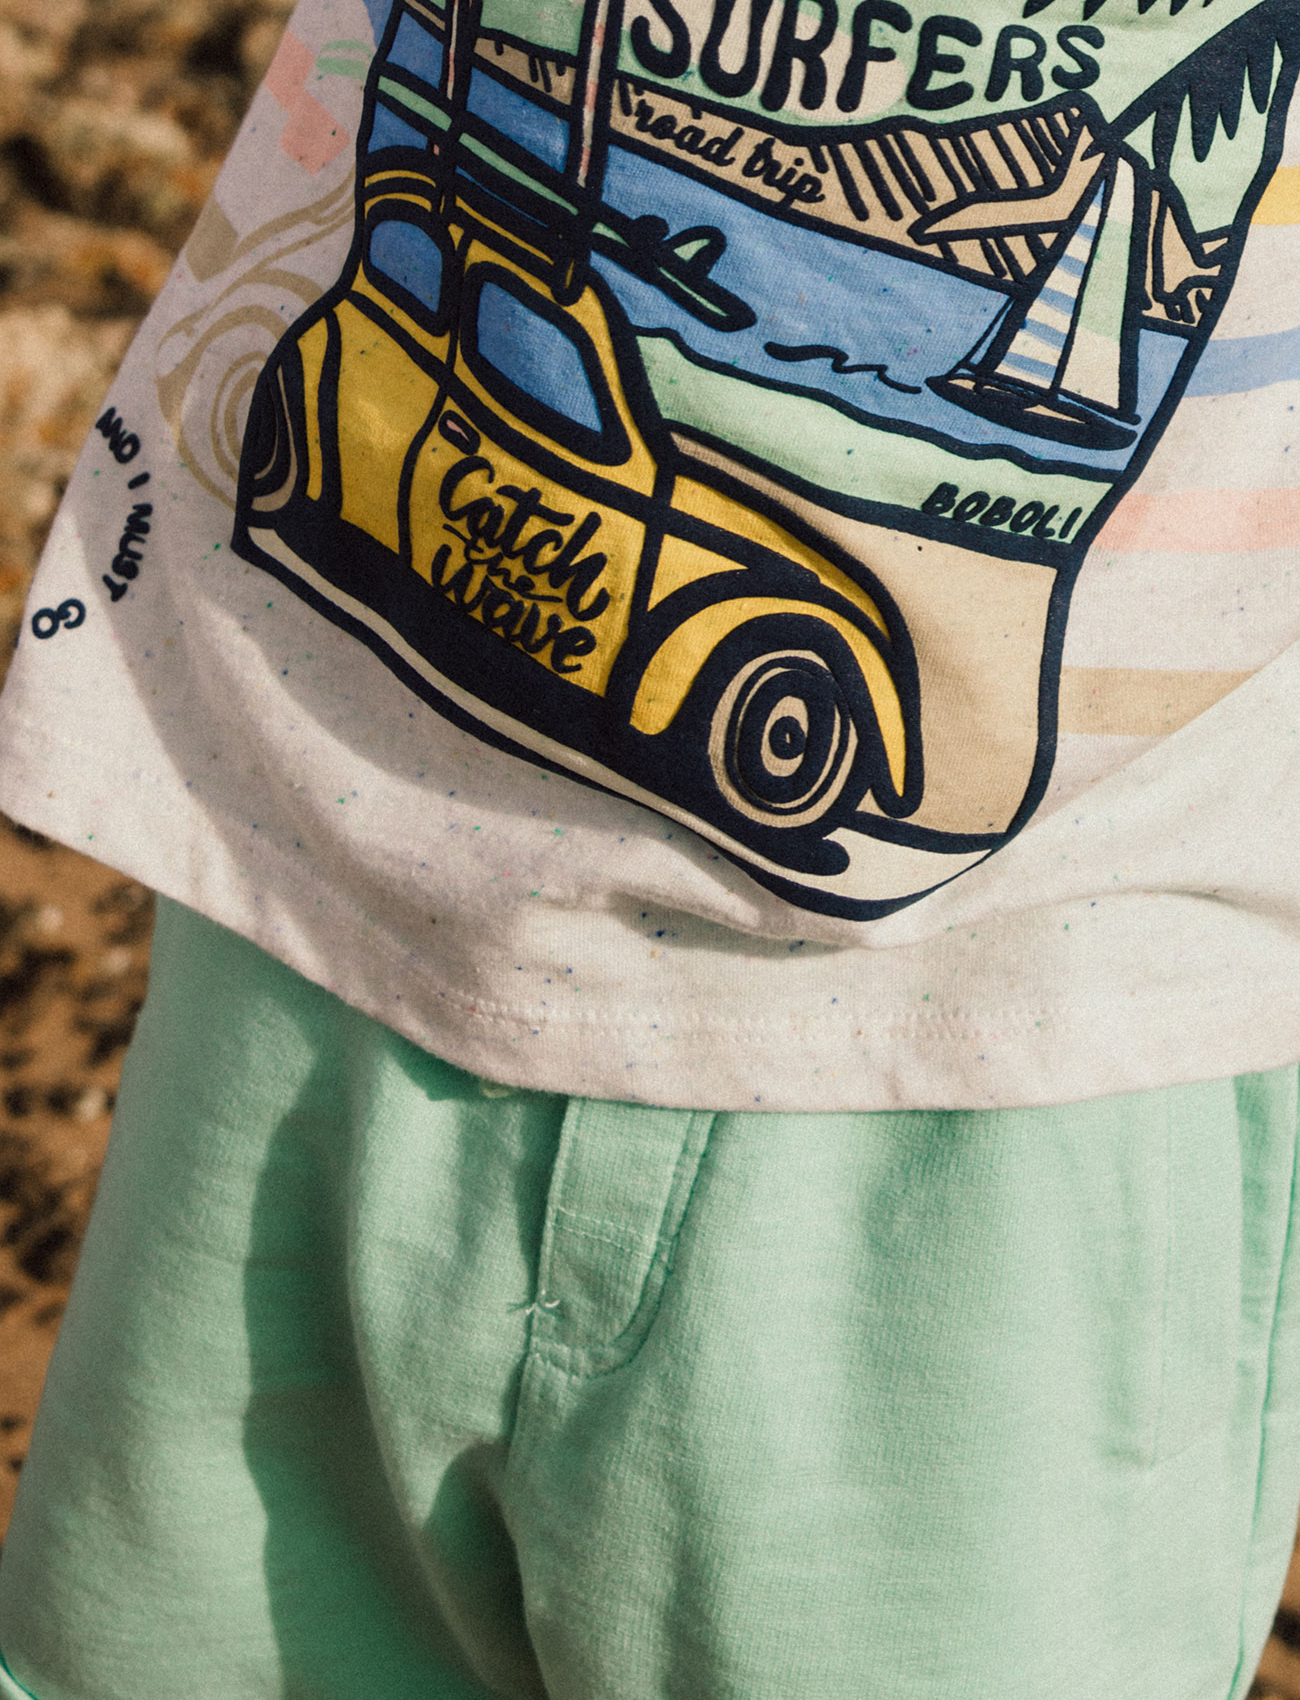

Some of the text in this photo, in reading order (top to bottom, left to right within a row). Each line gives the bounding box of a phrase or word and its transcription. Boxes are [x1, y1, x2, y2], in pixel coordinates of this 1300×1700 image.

[635, 99, 826, 208] road trip
[102, 502, 153, 602] MUST
[439, 456, 610, 622] Catch
[921, 481, 1083, 539] BOBOLI
[31, 598, 86, 639] GO
